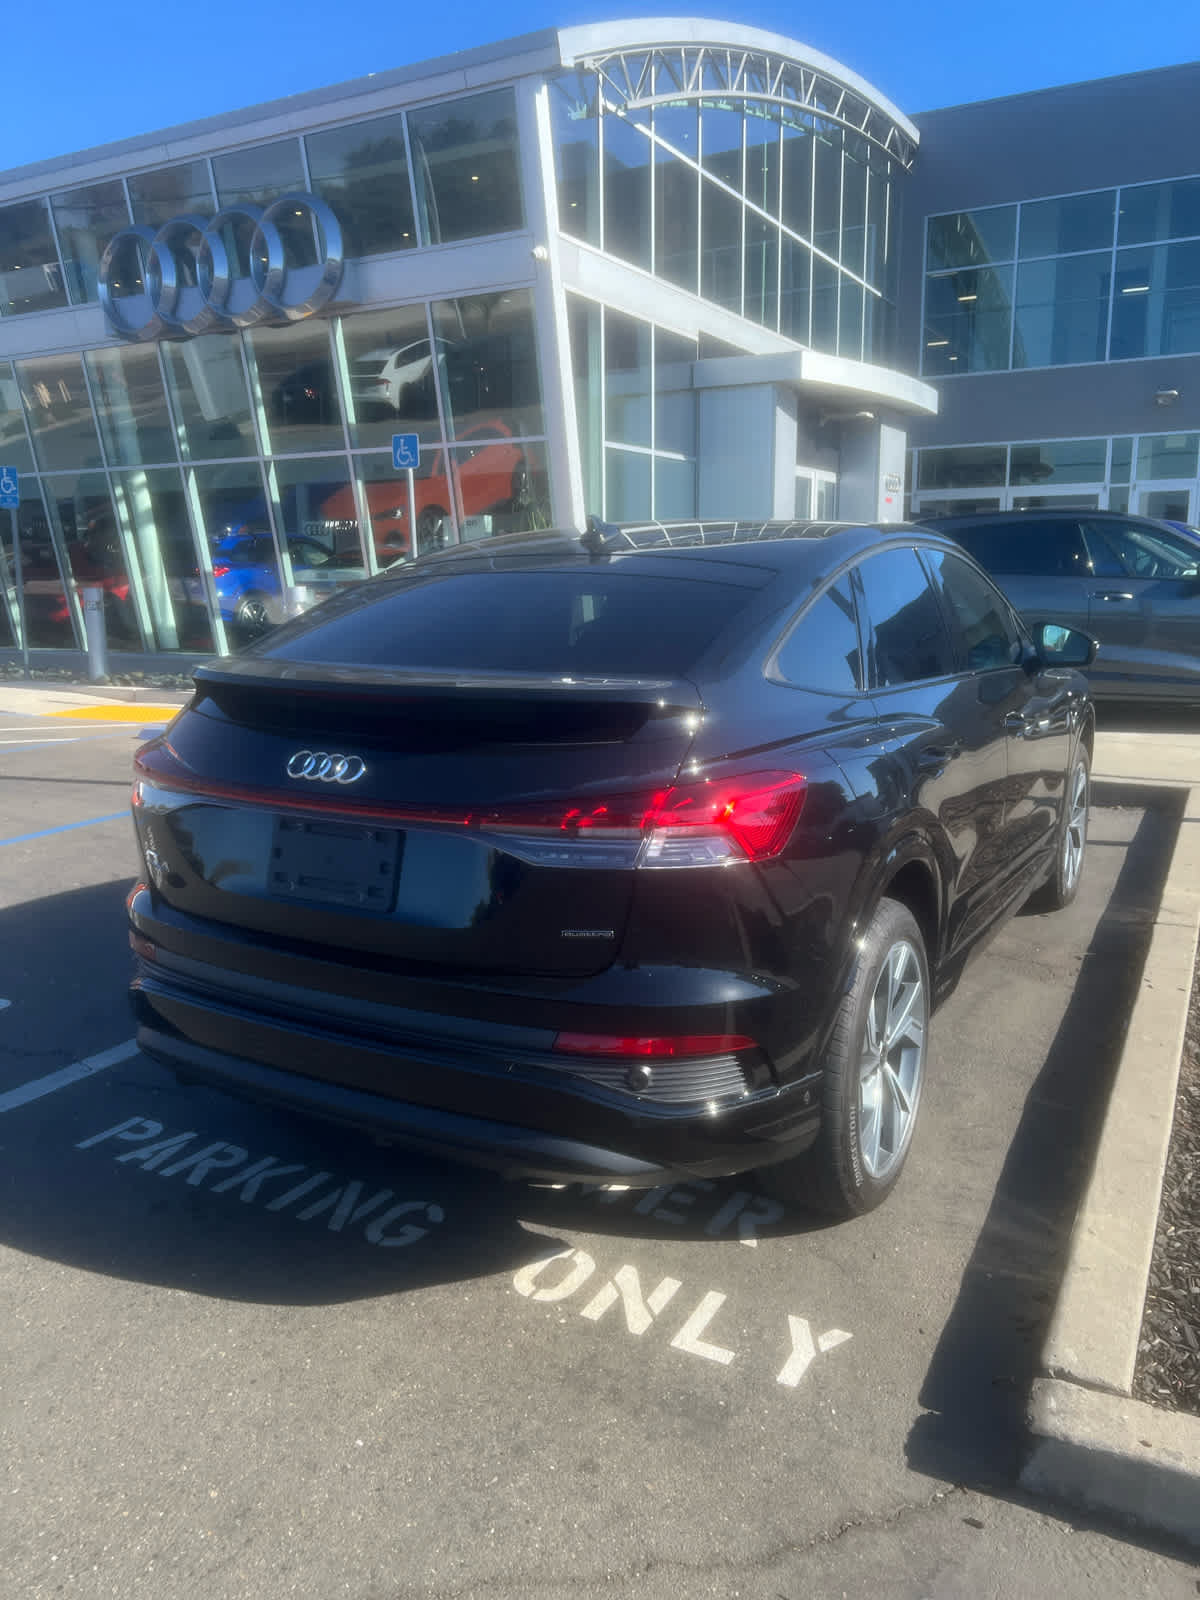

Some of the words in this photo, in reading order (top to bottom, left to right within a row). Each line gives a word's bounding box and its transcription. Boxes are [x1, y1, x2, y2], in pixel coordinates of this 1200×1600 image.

[75, 1116, 445, 1247] PARKING
[513, 1248, 853, 1387] ONLY
[582, 1178, 784, 1248] ER
